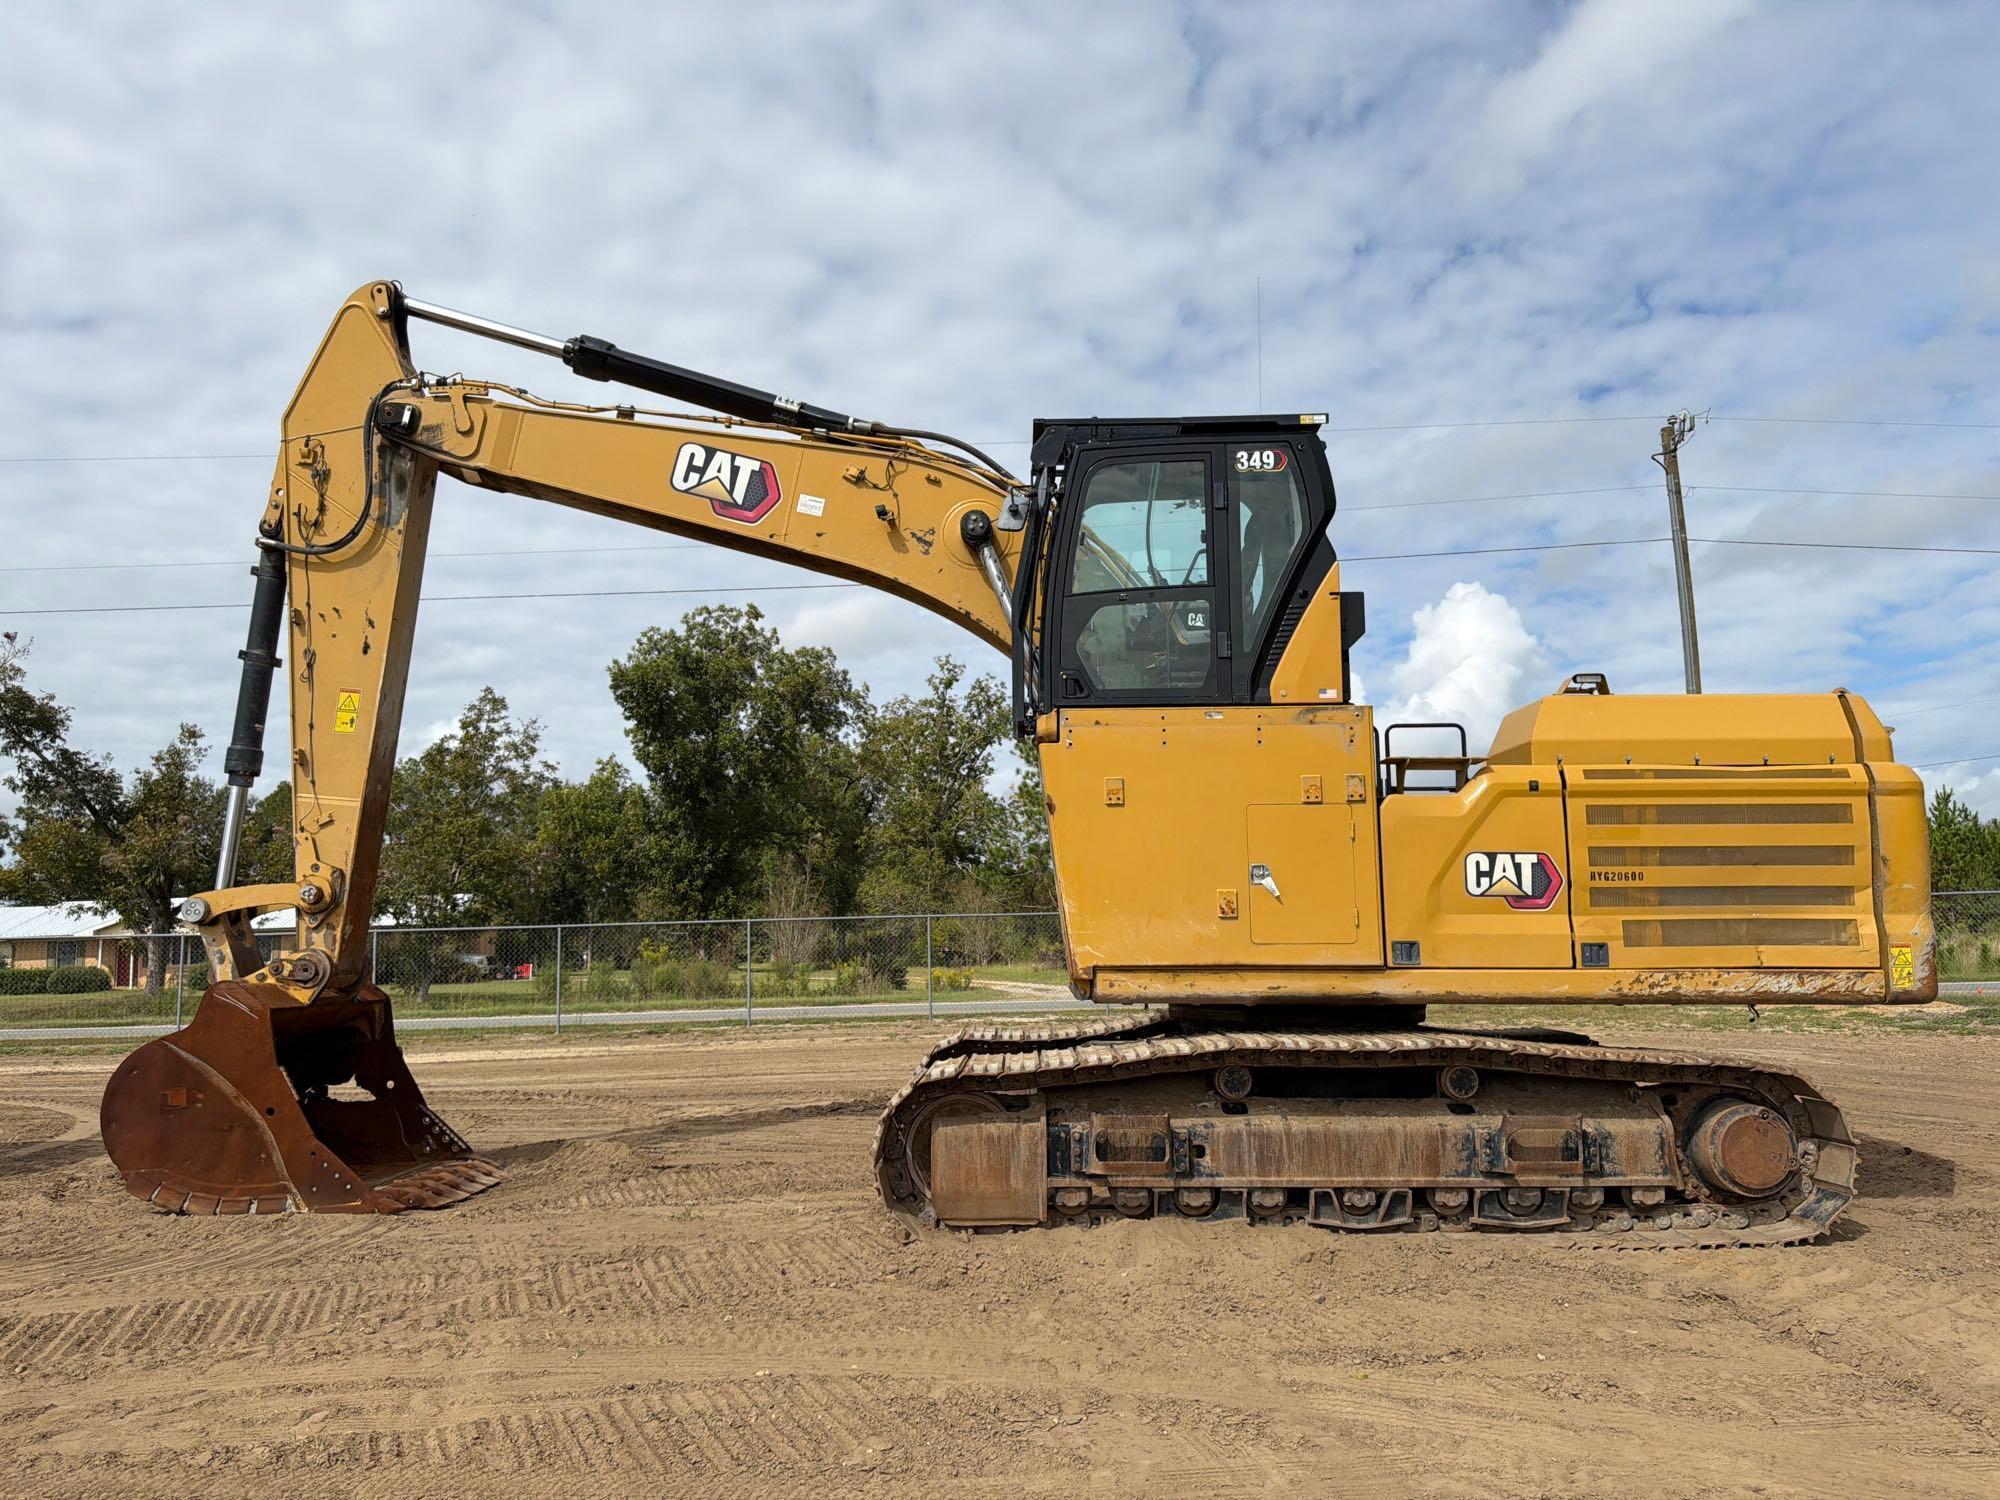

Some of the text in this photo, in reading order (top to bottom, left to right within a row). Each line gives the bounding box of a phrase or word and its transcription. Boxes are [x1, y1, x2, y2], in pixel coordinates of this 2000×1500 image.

[672, 443, 762, 506] CAT
[1236, 450, 1275, 470] 349
[1187, 612, 1206, 627] CA
[1465, 852, 1538, 896] CAT
